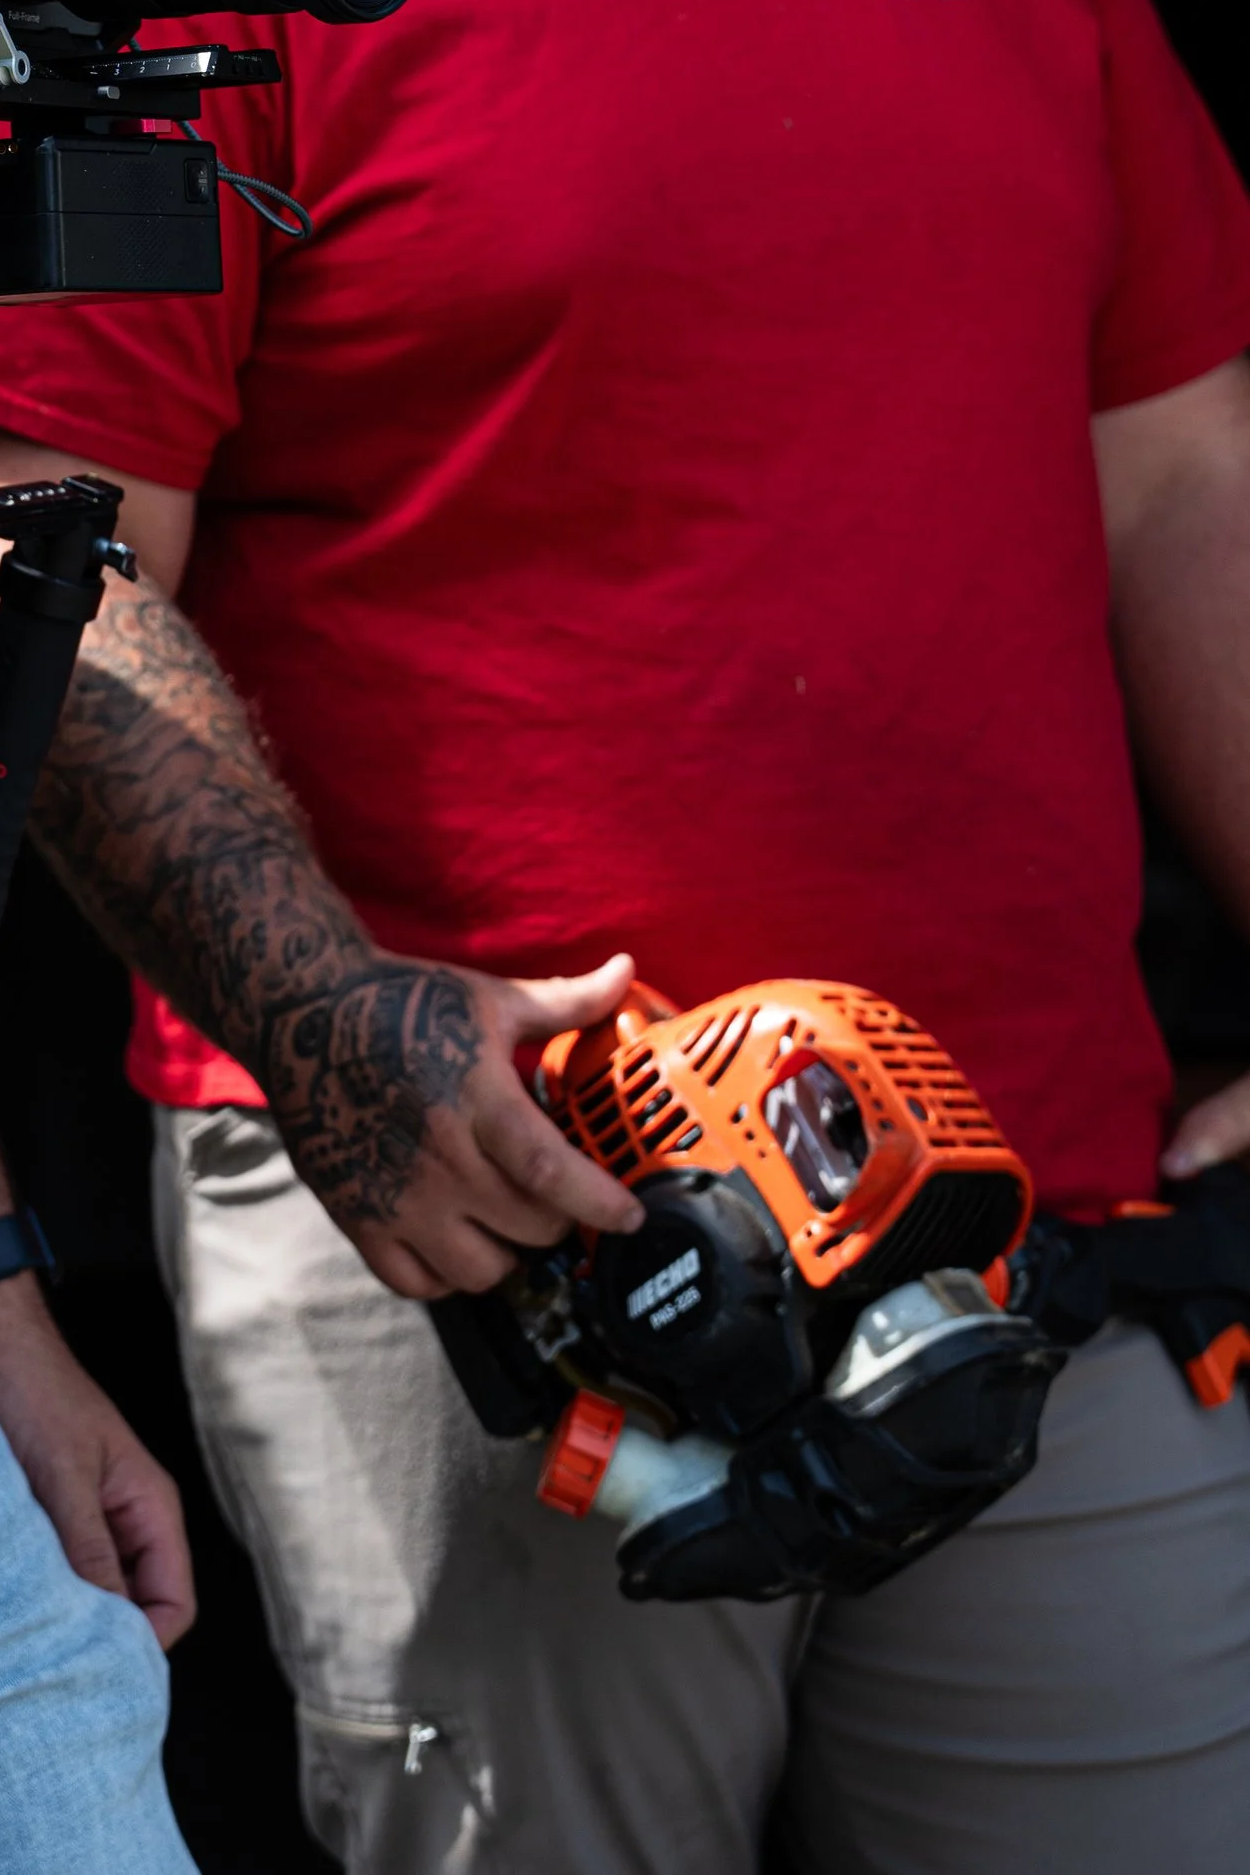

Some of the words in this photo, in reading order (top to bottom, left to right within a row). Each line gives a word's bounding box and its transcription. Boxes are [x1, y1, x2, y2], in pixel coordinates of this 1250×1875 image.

[114, 68, 120, 76] 3
[139, 66, 146, 74] 2
[635, 1247, 701, 1314] ECHO
